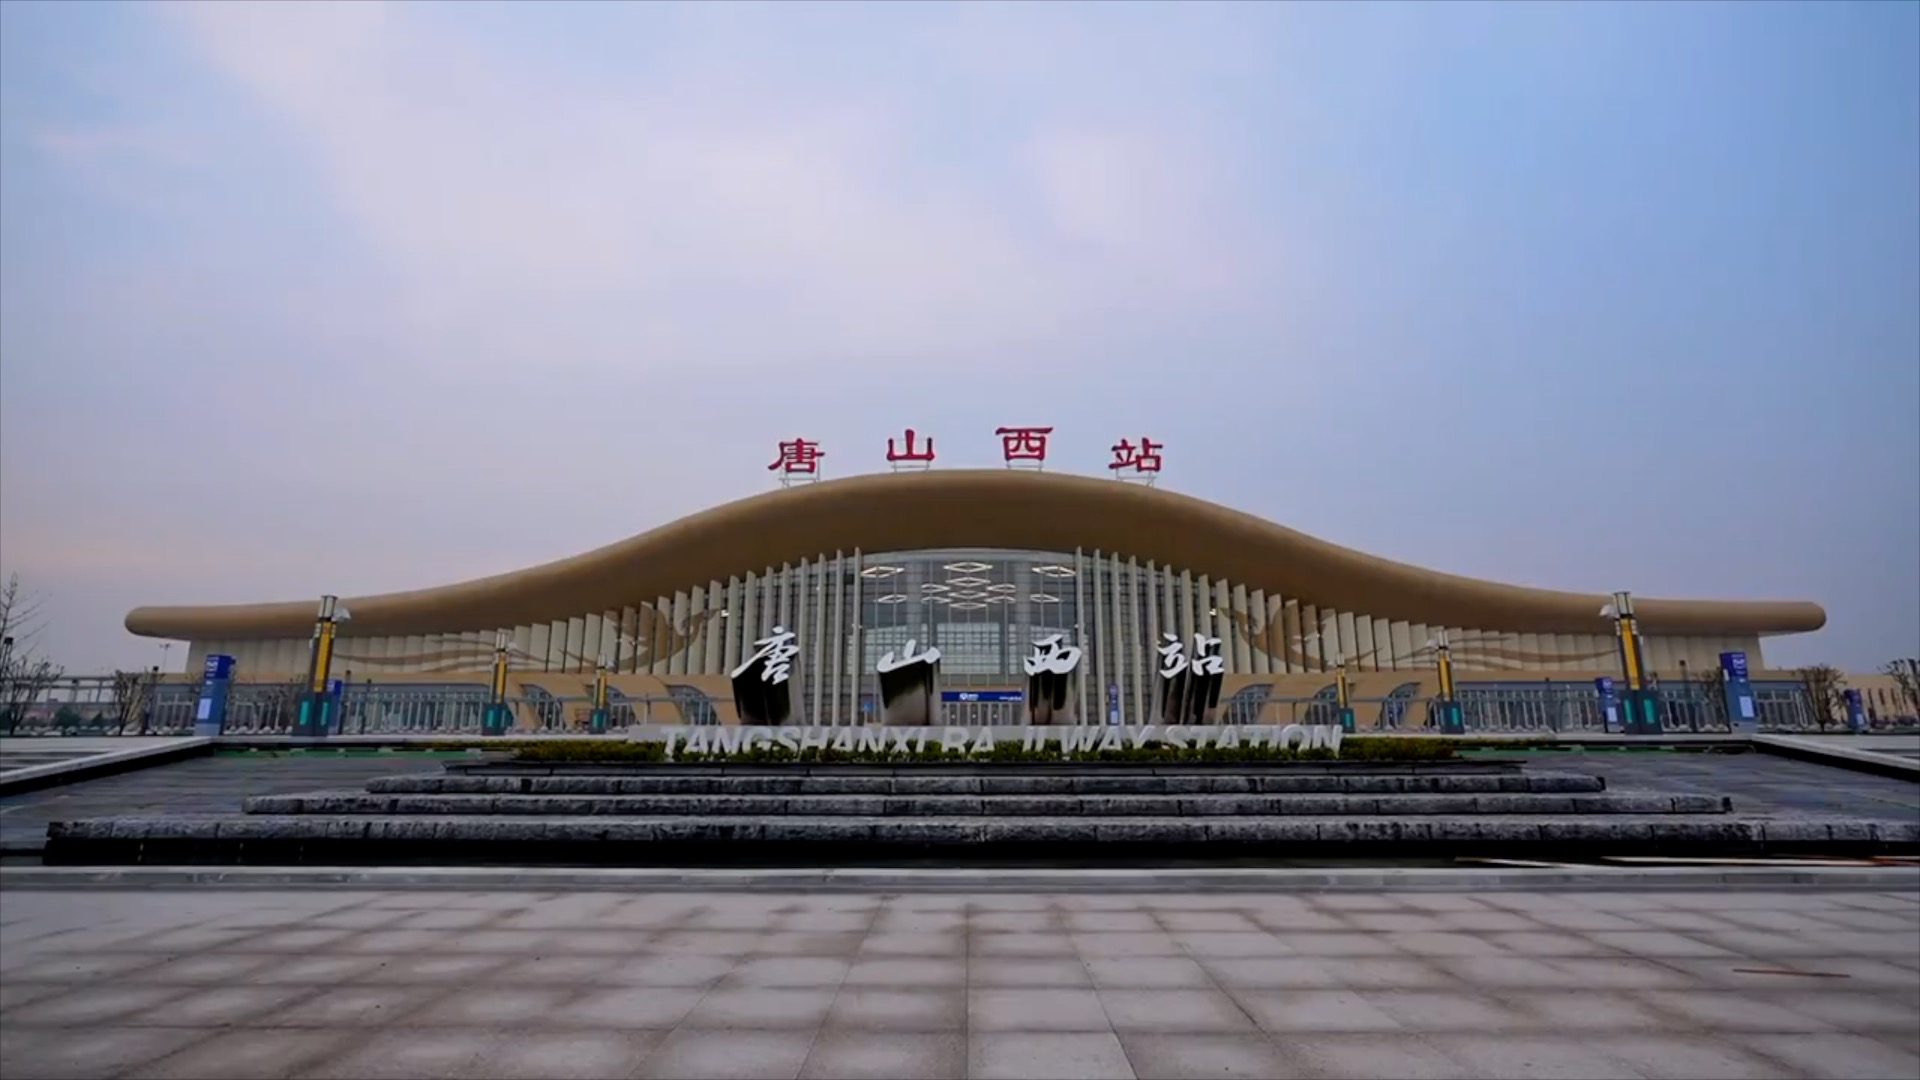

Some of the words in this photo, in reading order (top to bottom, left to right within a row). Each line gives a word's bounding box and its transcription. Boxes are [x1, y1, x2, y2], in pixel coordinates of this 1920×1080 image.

[767, 426, 1163, 474] 唐山西站
[731, 625, 1225, 685] 唐山西站
[660, 725, 932, 757] TANGSHANXI
[1164, 723, 1344, 758] STATION
